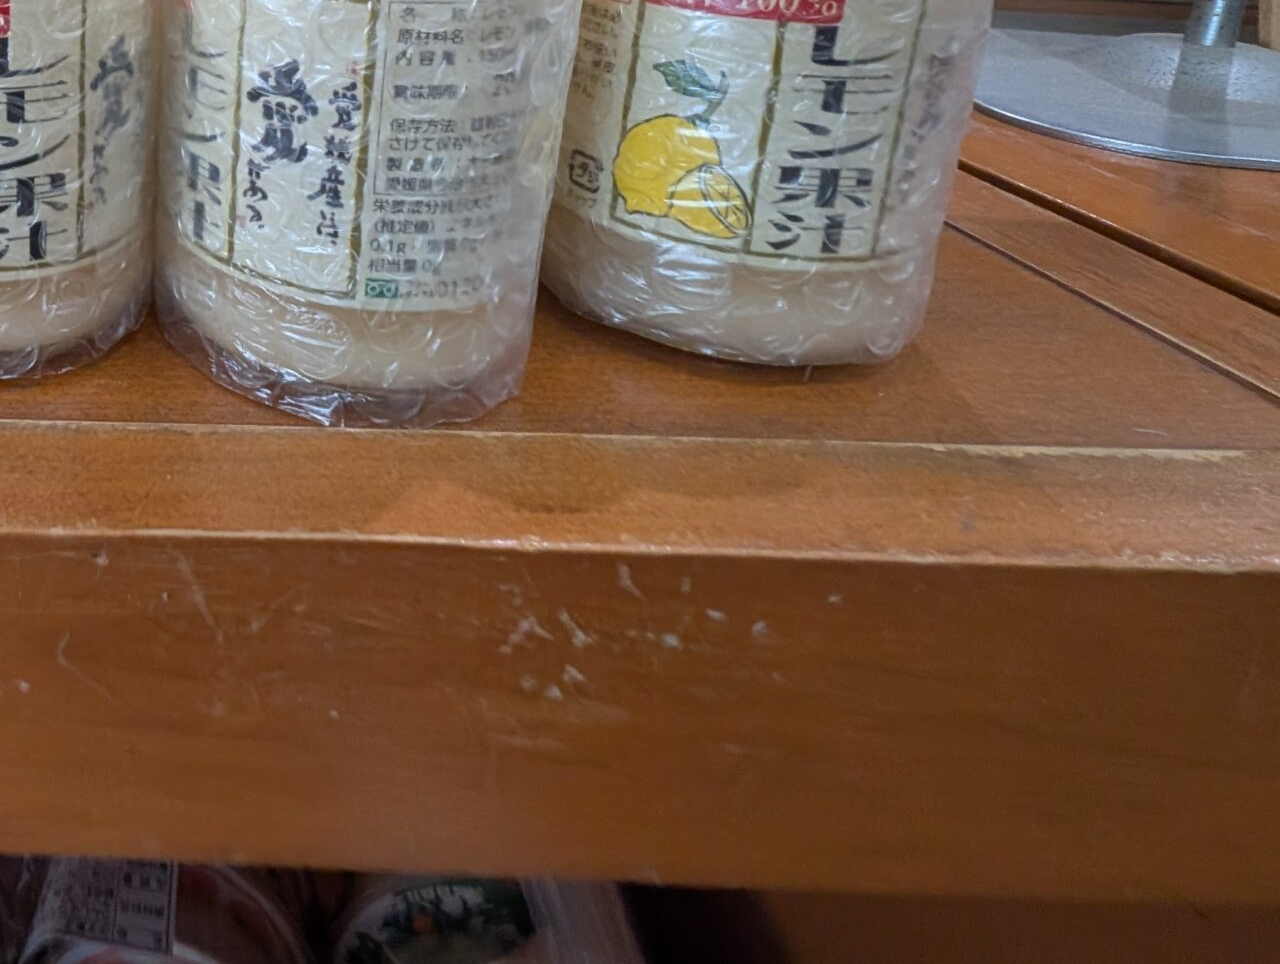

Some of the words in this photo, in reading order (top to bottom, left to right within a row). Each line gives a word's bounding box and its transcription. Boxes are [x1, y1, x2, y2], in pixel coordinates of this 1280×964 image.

[766, 26, 902, 253] レモン果汁
